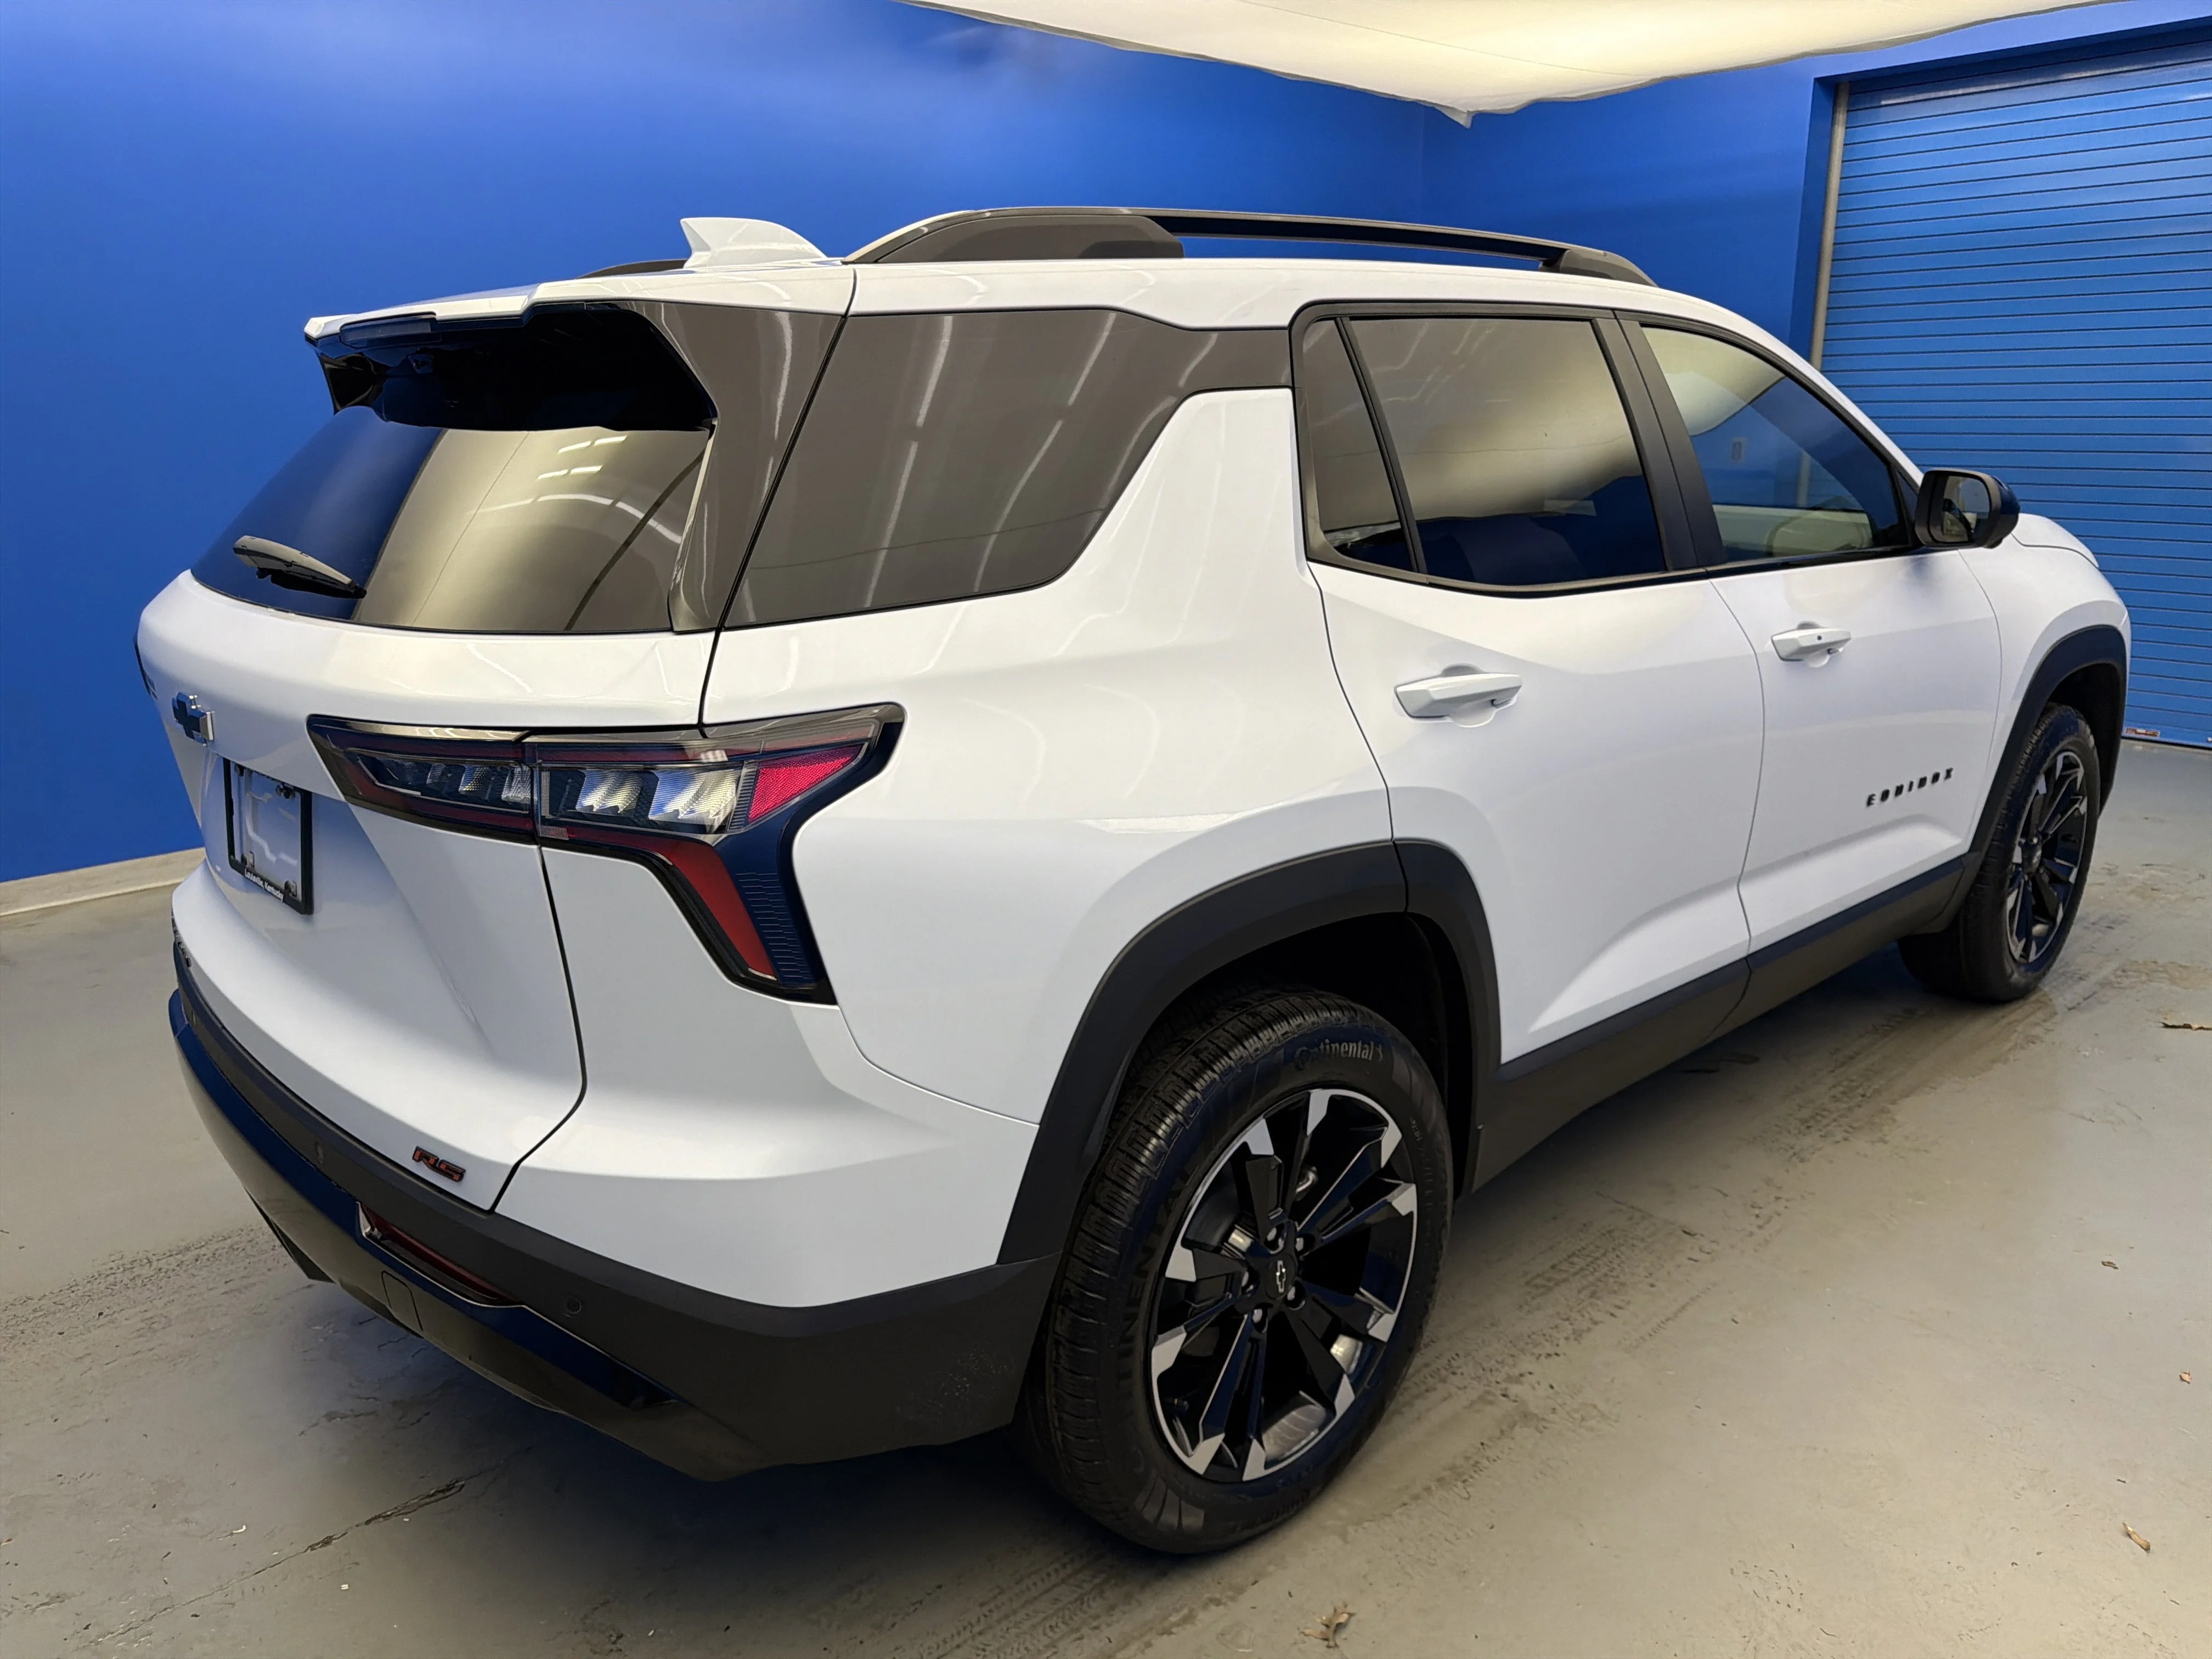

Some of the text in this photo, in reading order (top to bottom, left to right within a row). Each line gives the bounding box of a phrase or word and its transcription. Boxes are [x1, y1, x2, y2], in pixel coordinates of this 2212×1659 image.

[1866, 768, 1953, 807] EQUINOX
[264, 881, 284, 902] Kentucky
[1295, 1039, 1374, 1070] Continental
[412, 1146, 466, 1182] RS
